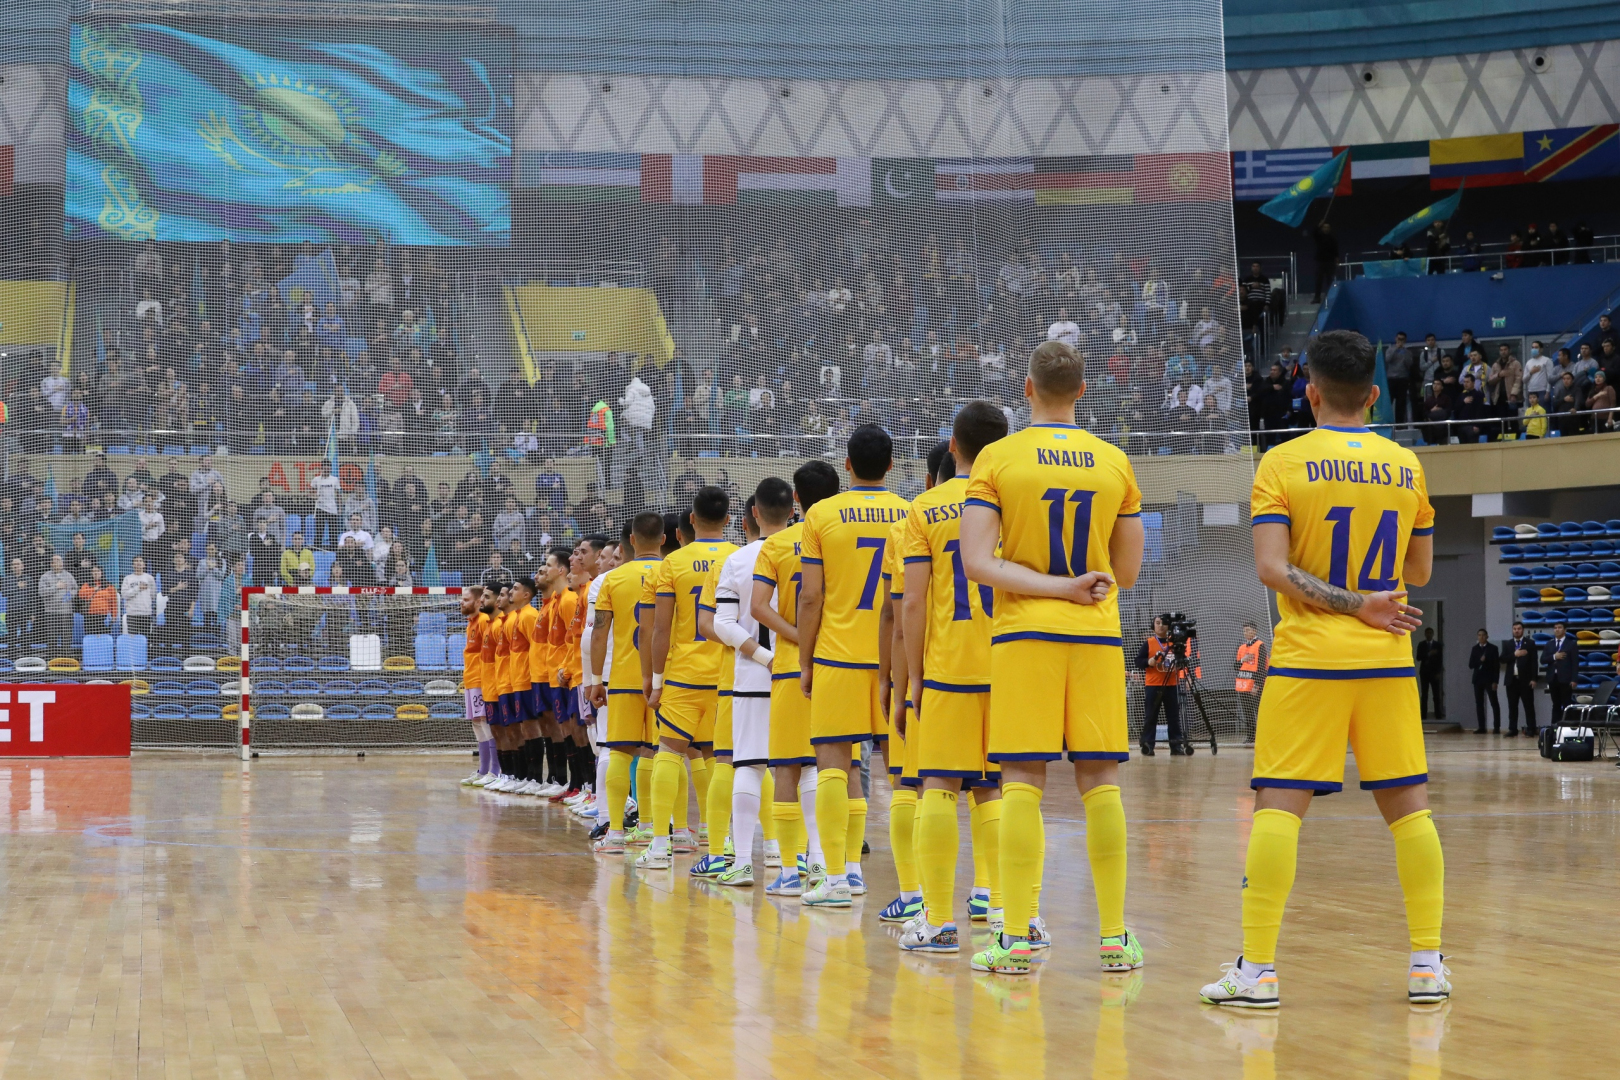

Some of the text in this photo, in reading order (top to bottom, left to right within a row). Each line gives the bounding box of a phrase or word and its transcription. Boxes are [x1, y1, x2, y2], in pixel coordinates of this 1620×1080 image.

[1036, 447, 1095, 468] KNAUB
[1305, 458, 1415, 490] DOUGLAS JR
[839, 507, 909, 523] VALIULLIN
[1040, 487, 1098, 578] 11
[856, 536, 887, 610] 7
[1323, 506, 1399, 592] 14
